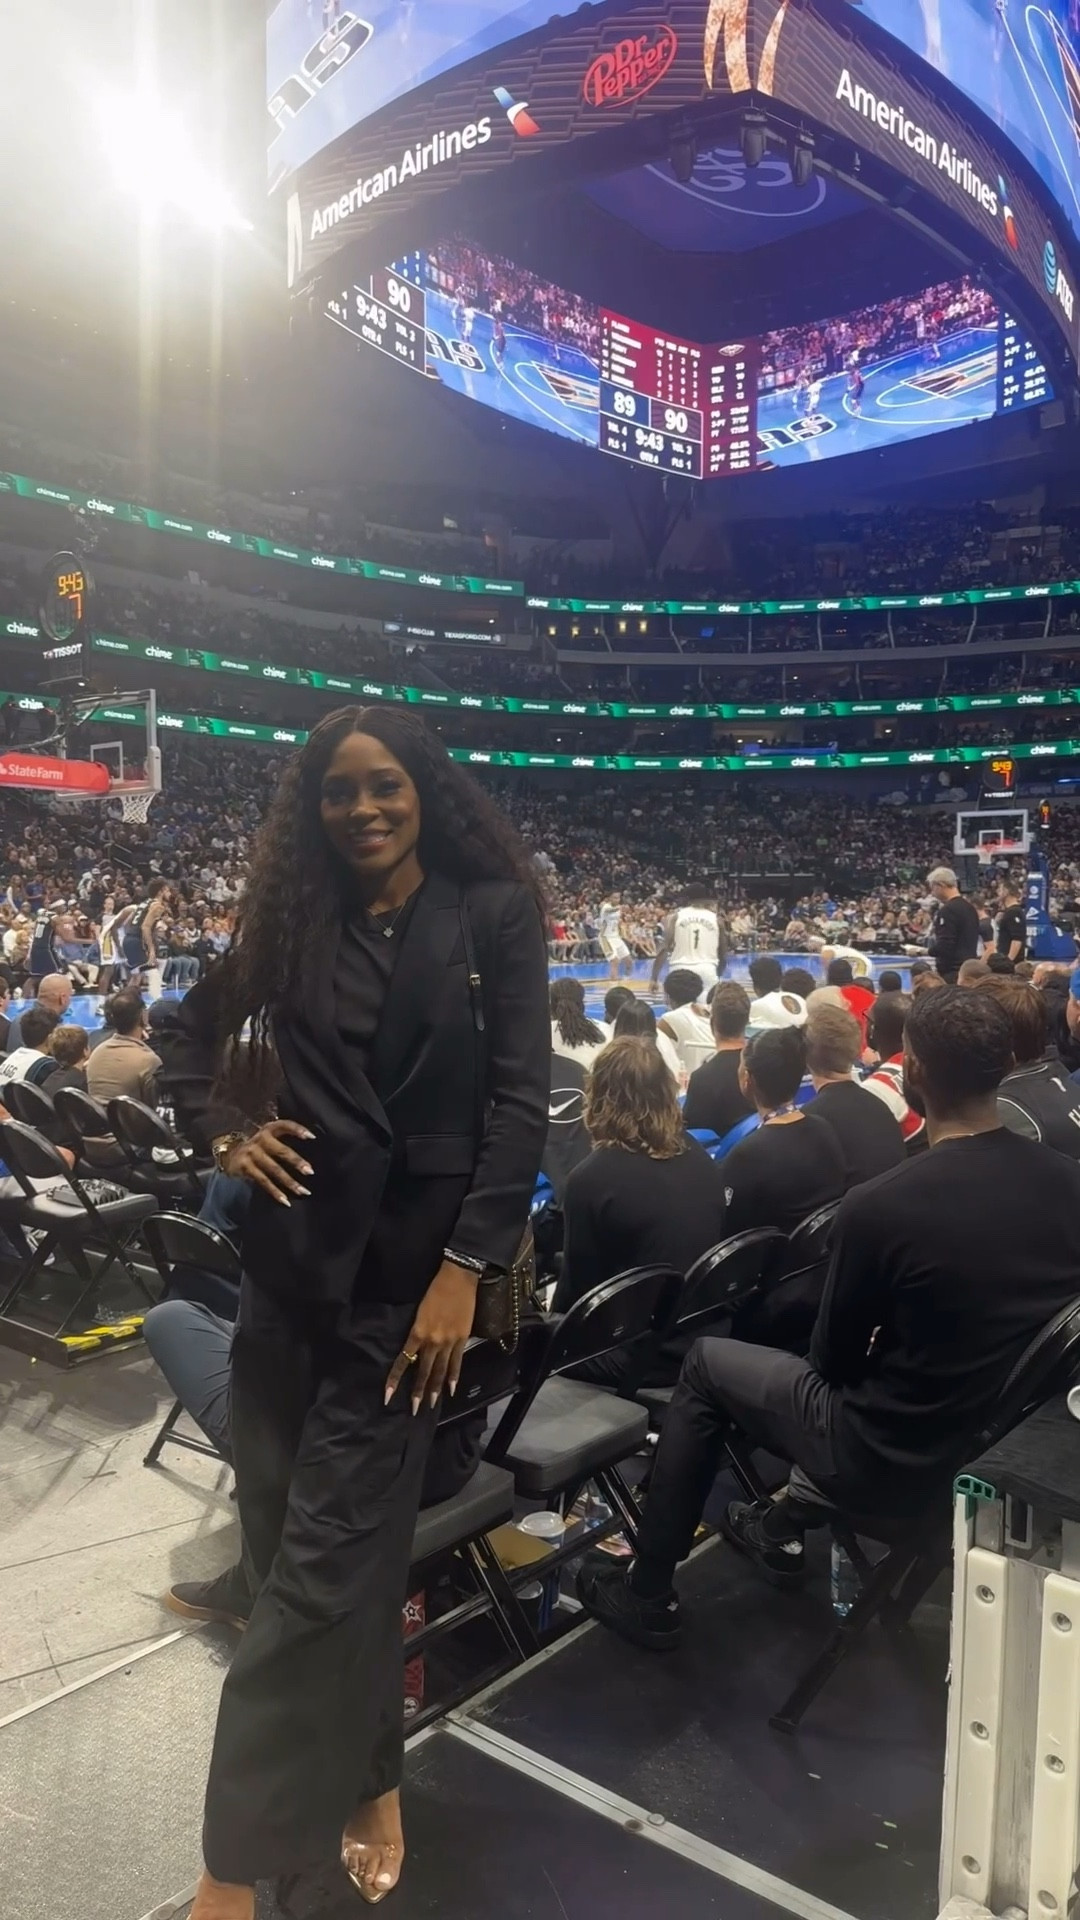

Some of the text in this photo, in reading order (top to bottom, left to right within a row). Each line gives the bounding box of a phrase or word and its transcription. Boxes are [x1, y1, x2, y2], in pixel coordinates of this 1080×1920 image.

[614, 34, 648, 74] Dr
[593, 39, 669, 108] Pepper
[835, 68, 998, 216] American Airlines
[310, 116, 492, 241] American Airlines
[356, 294, 388, 330] 9:43
[387, 278, 411, 313] 90
[614, 390, 689, 434] 89 90
[635, 427, 665, 452] 9:43
[36, 487, 70, 501] chime.com
[86, 499, 116, 514] chime
[164, 519, 193, 531] chime.com
[206, 529, 232, 544] chime
[311, 555, 336, 569] chime
[418, 573, 442, 587] chime
[68, 593, 81, 619] 7
[527, 598, 549, 608] chime
[621, 603, 644, 613] chime
[718, 603, 741, 613] chime
[817, 601, 841, 610] chime
[919, 596, 943, 606] chime
[1025, 587, 1050, 597] chime
[6, 621, 40, 637] chime
[95, 638, 129, 650] chime.com
[145, 645, 173, 660] chime
[263, 665, 287, 680] chime
[362, 683, 384, 696] chime
[460, 696, 483, 708] chime
[562, 703, 587, 714] chime
[669, 706, 695, 716] chime
[780, 705, 806, 716] chime
[896, 702, 923, 712] chime
[1017, 694, 1046, 705] chime
[53, 643, 82, 659] TISSOT
[103, 710, 136, 721] chime.com
[157, 714, 185, 729] chime
[273, 729, 297, 743] chime
[469, 752, 491, 763] chime
[571, 757, 595, 767] chime
[678, 759, 703, 769] chime
[790, 757, 816, 767] chime
[908, 752, 935, 763] chime
[1030, 746, 1057, 756] chime
[999, 770, 1010, 786] 7
[692, 928, 701, 950] 1
